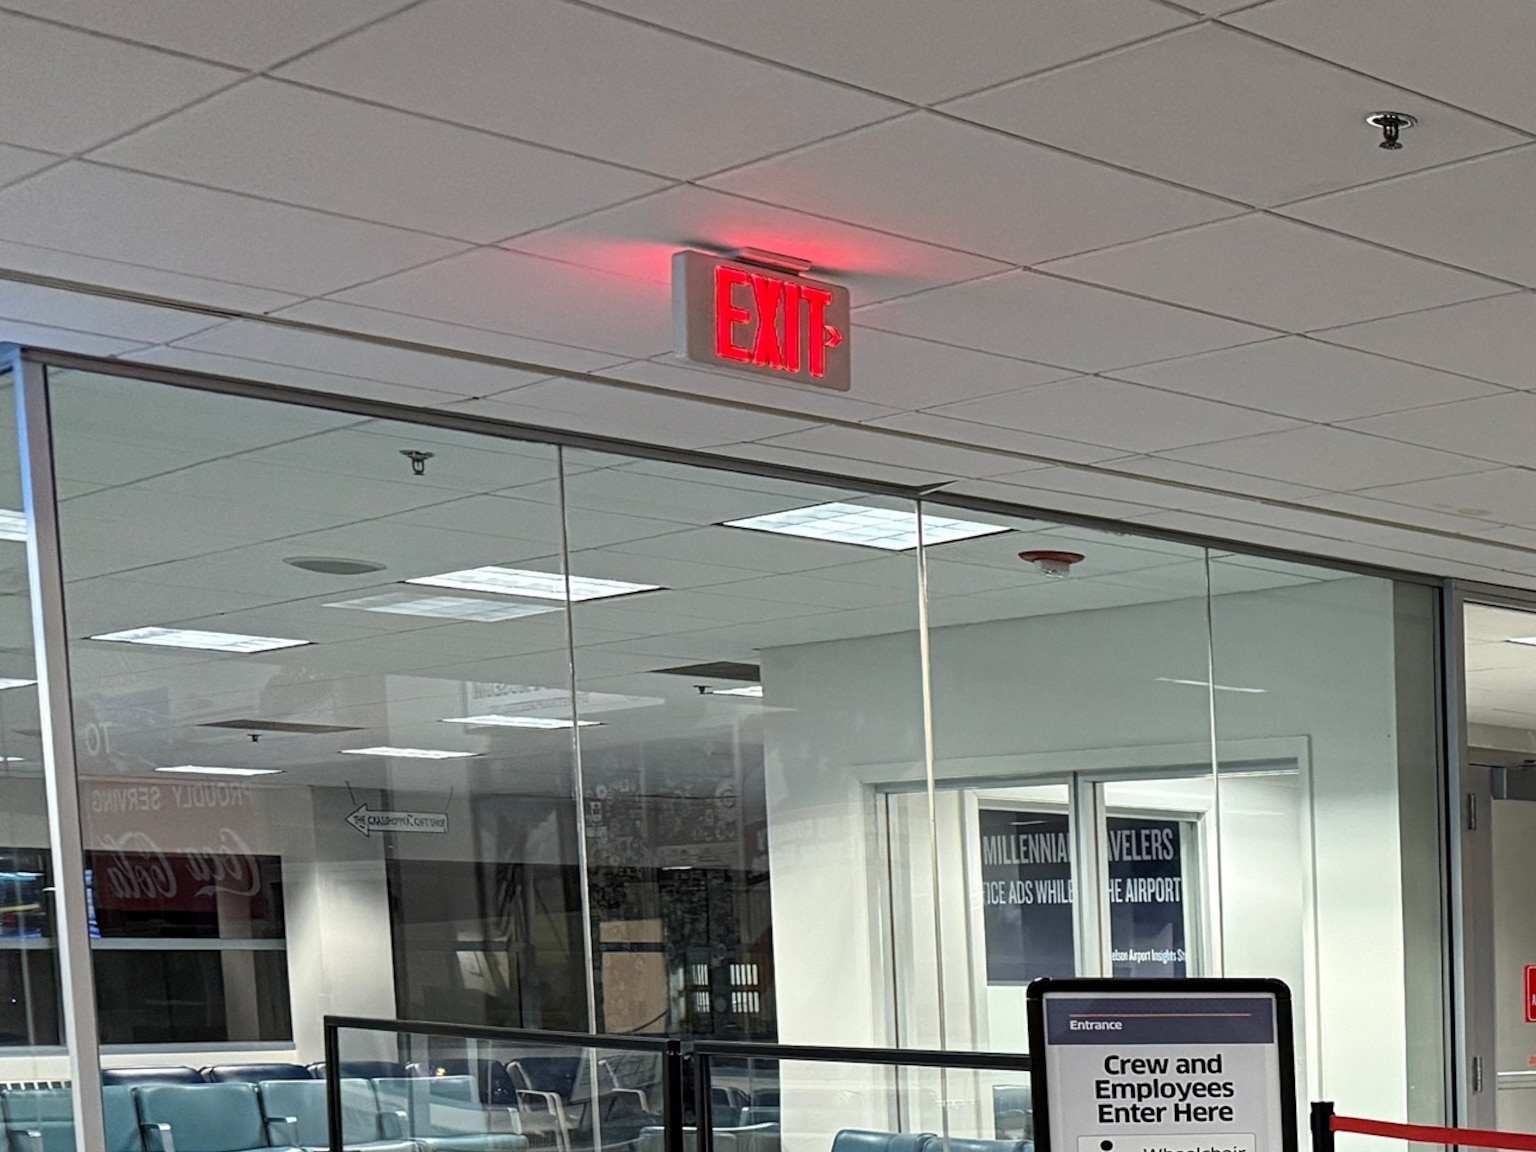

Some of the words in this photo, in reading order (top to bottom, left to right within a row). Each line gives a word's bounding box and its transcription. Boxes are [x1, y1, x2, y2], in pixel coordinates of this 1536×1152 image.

[715, 265, 832, 378] EXIT
[1109, 827, 1175, 862] VELERS
[1008, 879, 1034, 905] ADS
[1108, 877, 1123, 903] HE
[1125, 876, 1181, 903] AIRPORT
[1112, 948, 1128, 962] elson
[1129, 948, 1151, 964] Airport
[1151, 948, 1176, 965] Insights
[1069, 1020, 1123, 1031] Entrance
[1104, 1054, 1169, 1075] Crew
[1175, 1053, 1223, 1074] and
[1095, 1078, 1235, 1102] Employees
[1098, 1104, 1166, 1124] Enter
[1174, 1103, 1234, 1123] Here
